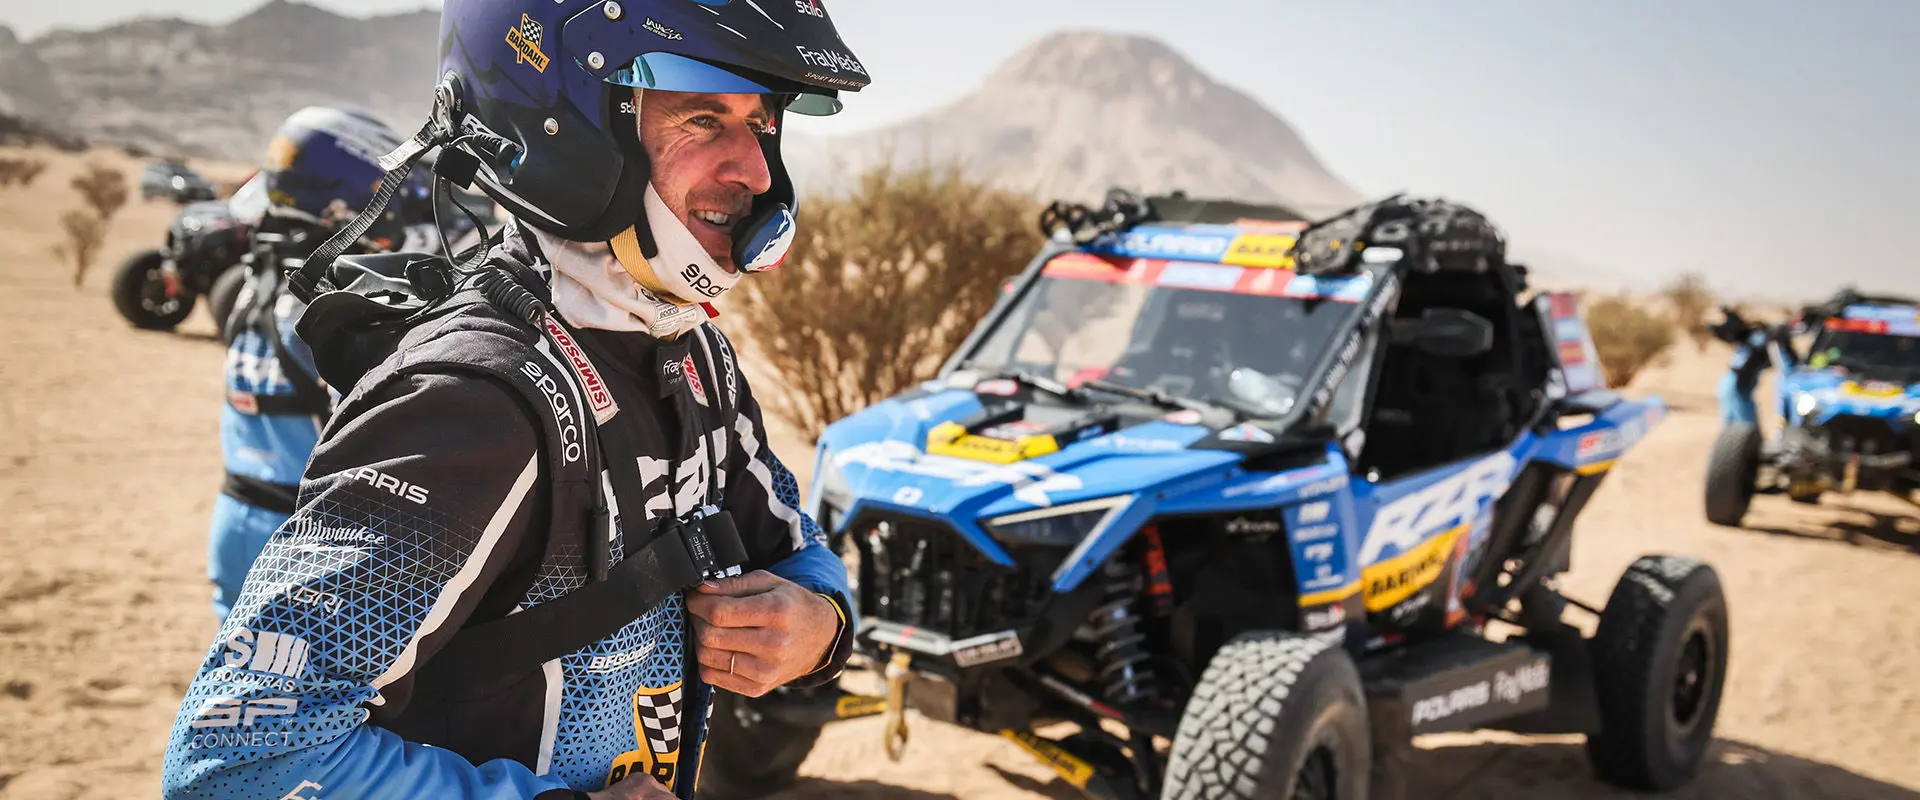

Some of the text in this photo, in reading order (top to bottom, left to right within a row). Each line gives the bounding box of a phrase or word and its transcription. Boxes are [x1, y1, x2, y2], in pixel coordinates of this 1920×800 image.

[508, 30, 546, 70] BARDAHL
[546, 322, 608, 405] SIMPSON
[520, 361, 581, 463] sparco
[292, 514, 386, 546] Milwaukee
[214, 669, 297, 693] SOCOTRAS
[190, 731, 293, 750] CONNECT
